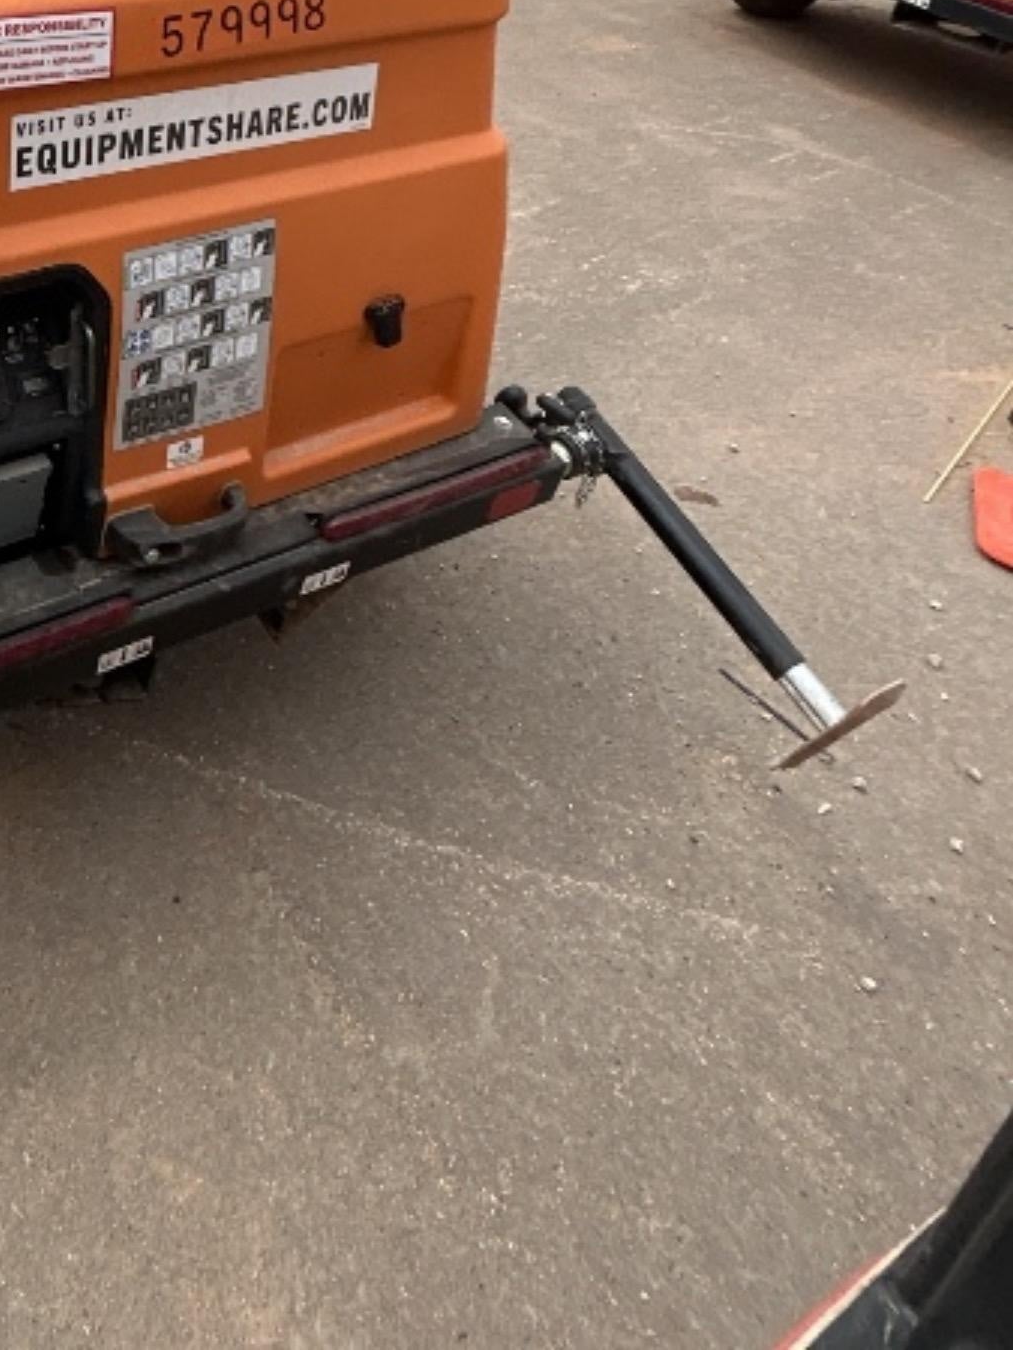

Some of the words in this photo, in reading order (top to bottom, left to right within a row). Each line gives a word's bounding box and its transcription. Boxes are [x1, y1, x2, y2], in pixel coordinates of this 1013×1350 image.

[4, 16, 107, 37] RESPONSIBILITY
[15, 91, 372, 179] EQUIPMENTSHARE.COM
[16, 116, 66, 138] VISIT
[74, 111, 97, 128] US
[105, 106, 133, 124] AT:
